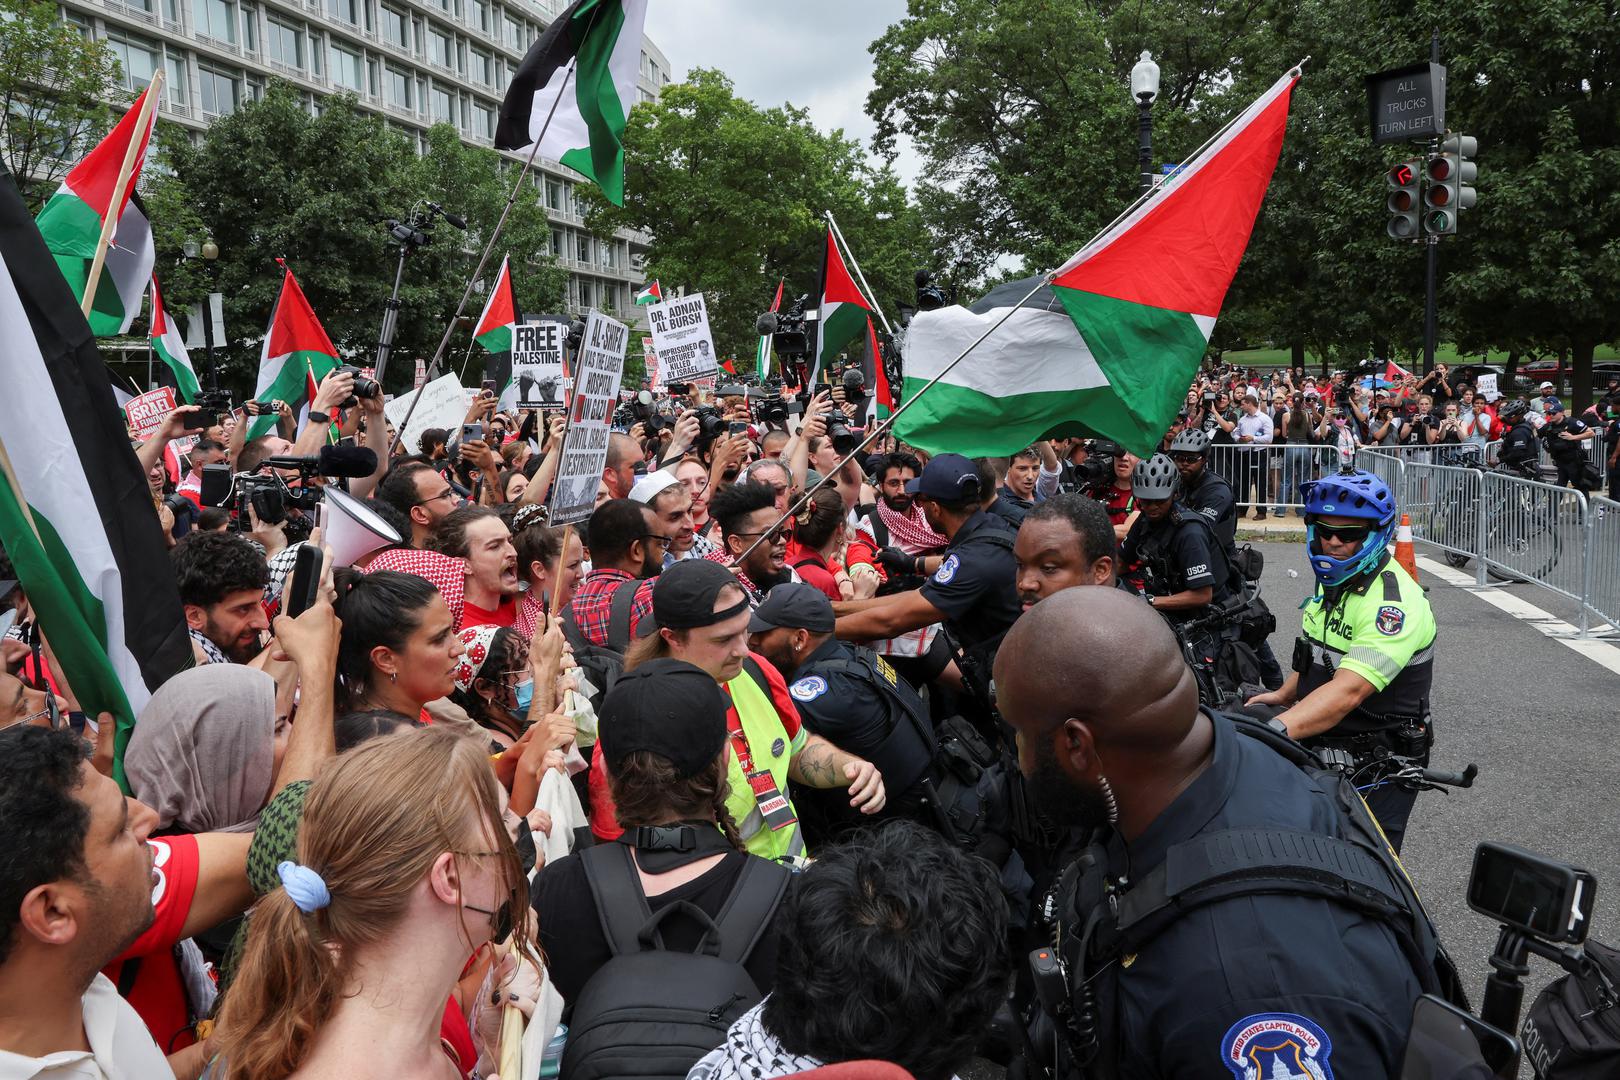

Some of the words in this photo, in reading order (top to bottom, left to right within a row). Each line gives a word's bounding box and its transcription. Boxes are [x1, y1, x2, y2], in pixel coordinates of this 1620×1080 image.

[1397, 80, 1416, 93] ALL
[1387, 97, 1426, 113] TRUCKS
[1378, 120, 1406, 134] TURN
[1408, 115, 1433, 129] LEFT
[650, 310, 667, 323] DR.
[669, 300, 702, 318] ADNAN
[656, 321, 668, 333] AL
[669, 312, 702, 330] BURSH
[516, 326, 557, 352] FREE
[591, 319, 624, 353] AL-SHIFA
[514, 351, 560, 365] PALESTINE
[659, 342, 698, 358] IMPRISONED
[664, 351, 695, 364] TORTURED
[584, 350, 596, 368] WAS
[596, 352, 605, 370] THE
[604, 354, 622, 373] LARGEST
[670, 360, 691, 370] KILLED
[677, 366, 699, 376] ISRAEL
[586, 372, 613, 396] HOSPITAL
[128, 400, 140, 411] STOP
[142, 390, 167, 404] ARMING
[130, 398, 173, 421] ISRAEL
[582, 398, 591, 419] IN
[591, 399, 606, 420] GAZA
[140, 414, 158, 427] FUND
[568, 427, 588, 450] UNTIL
[588, 428, 607, 450] ISRAEL
[562, 453, 599, 476] DESTROYED
[597, 453, 605, 474] IT
[1187, 564, 1207, 576] USCP
[1381, 606, 1402, 617] POLICE
[1326, 617, 1352, 640] POLICE
[760, 799, 787, 813] MARSHAL
[1232, 1040, 1243, 1060] UNITED
[1242, 1024, 1265, 1040] STATES
[1265, 1023, 1294, 1033] CAPITOL
[1294, 1028, 1319, 1049] POLICE
[1522, 1018, 1551, 1079] POLICE
